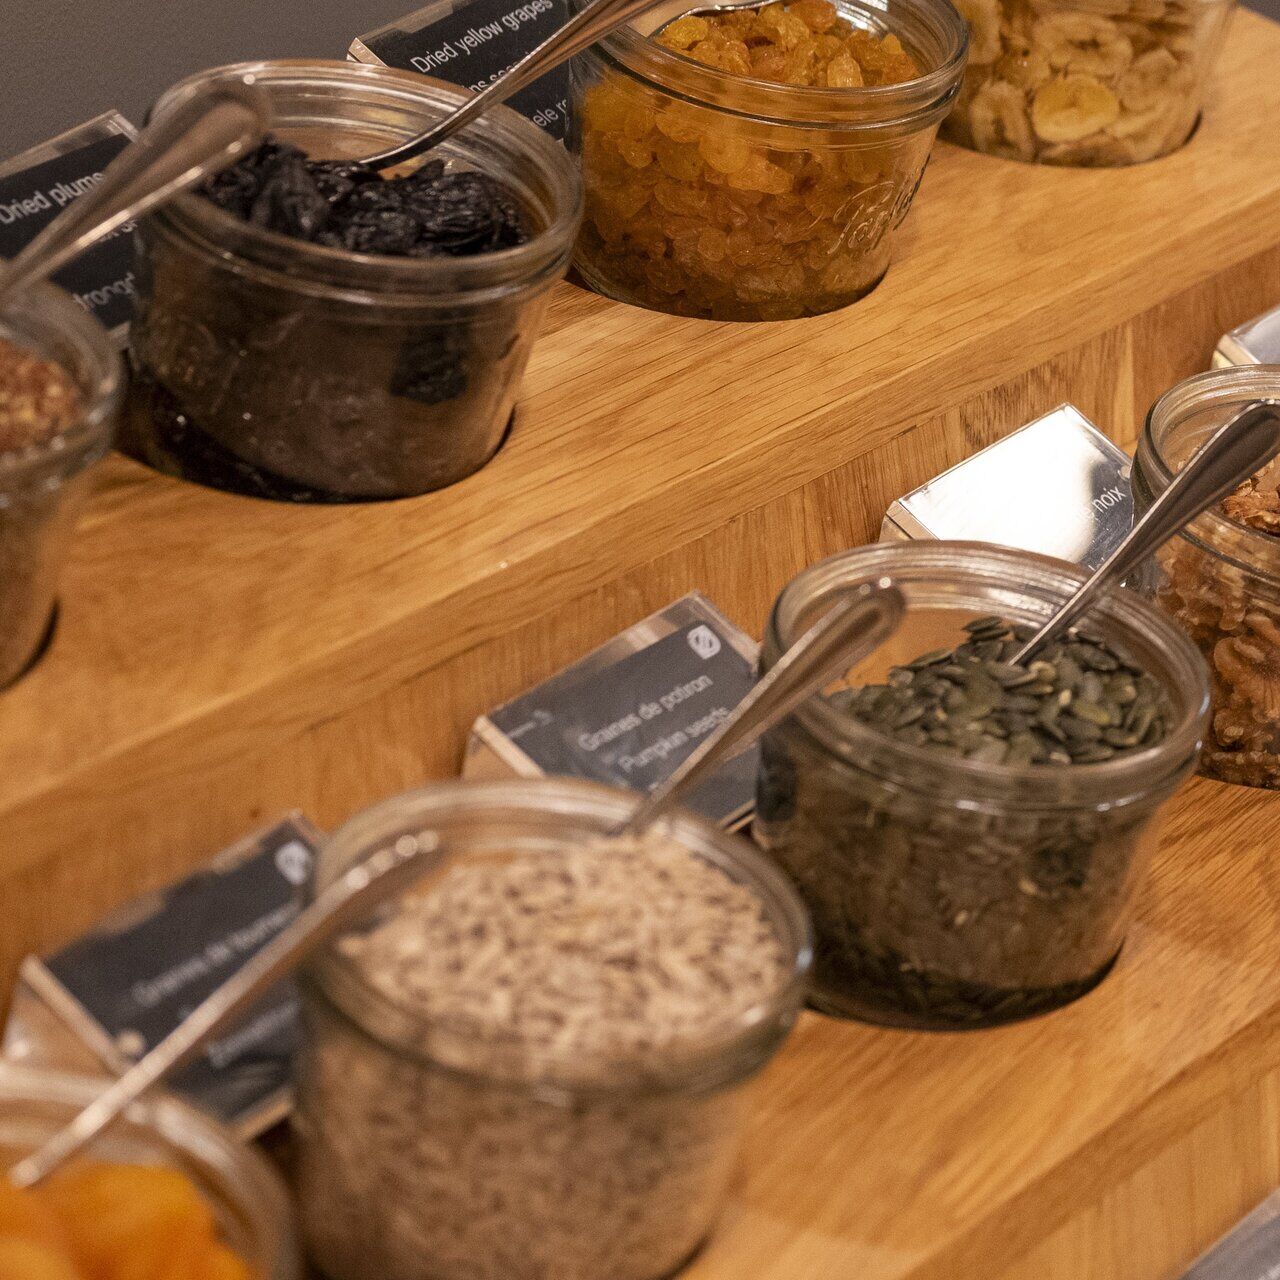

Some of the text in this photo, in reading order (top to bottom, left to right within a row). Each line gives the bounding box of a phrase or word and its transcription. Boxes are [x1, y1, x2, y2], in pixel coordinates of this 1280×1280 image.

[410, 42, 459, 73] Dried
[455, 20, 503, 55] yellow
[0, 190, 52, 224] Dried
[1092, 486, 1126, 513] noix
[638, 702, 662, 720] de
